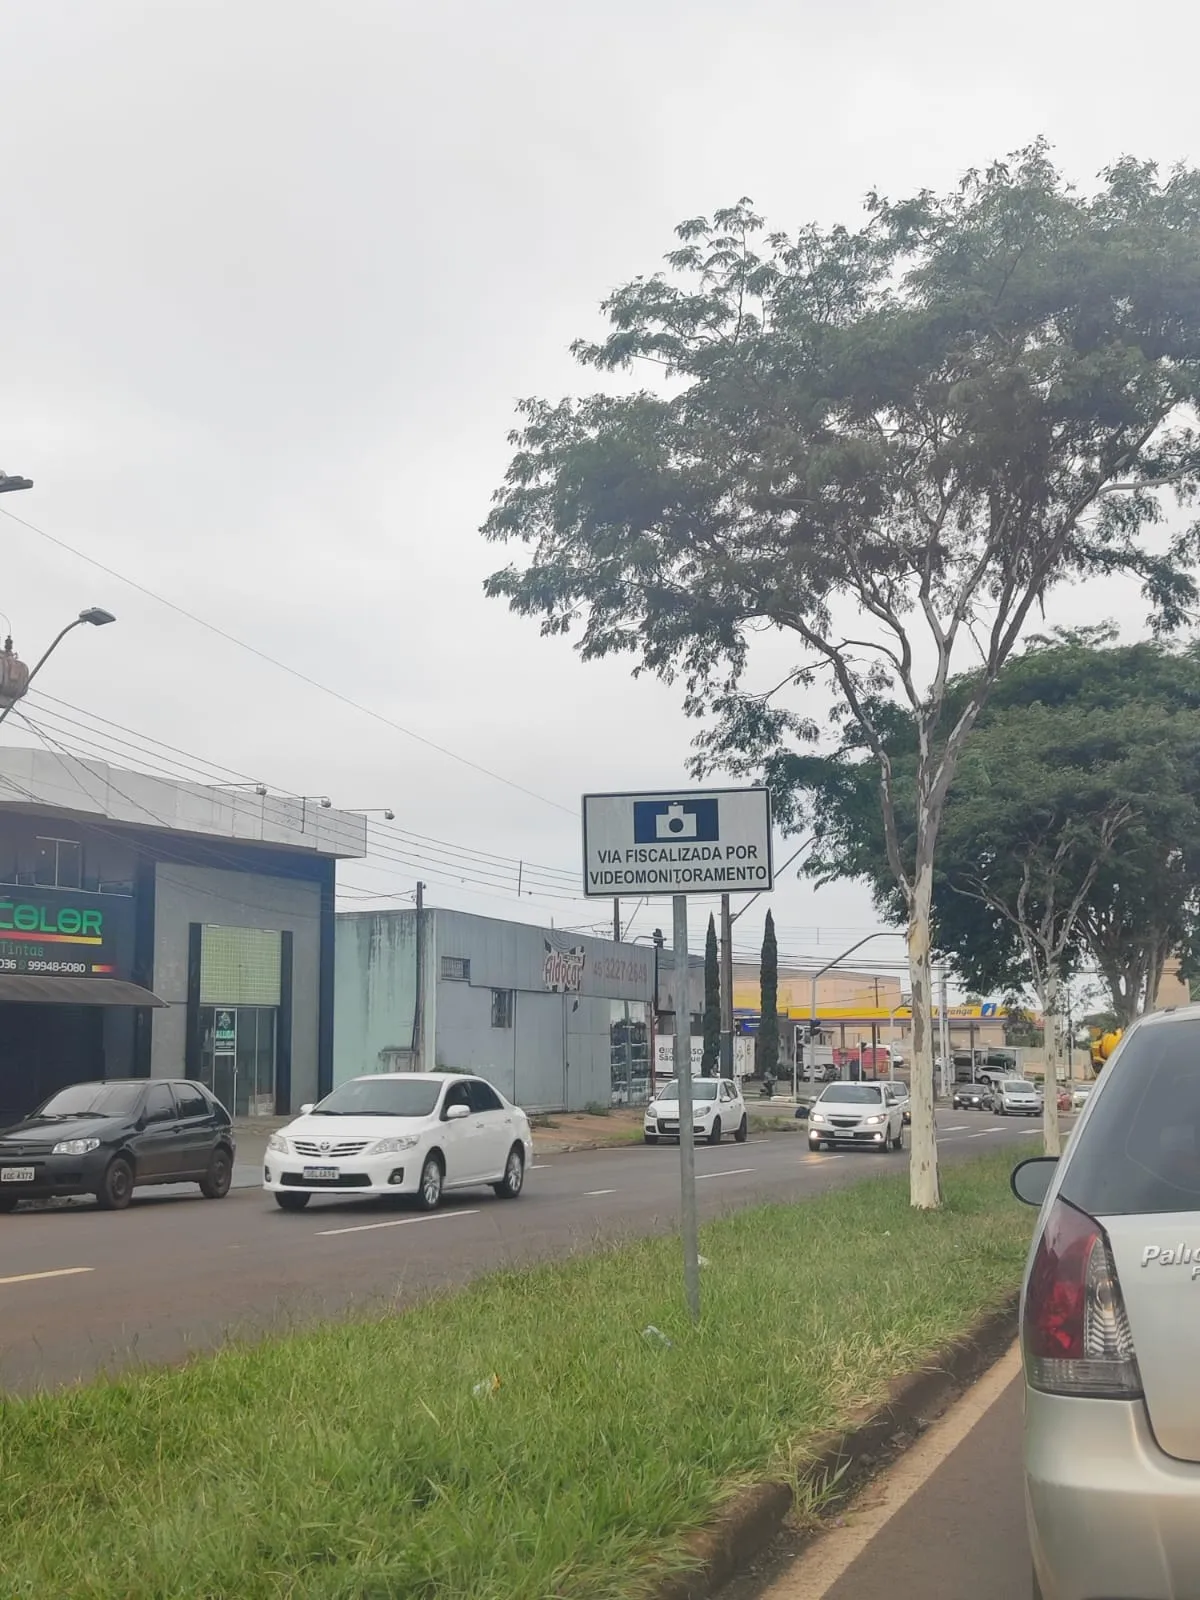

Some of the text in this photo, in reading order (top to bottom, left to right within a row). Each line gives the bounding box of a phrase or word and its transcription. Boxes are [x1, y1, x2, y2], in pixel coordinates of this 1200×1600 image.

[598, 845, 758, 864] VIA FISCALIZADA POR
[590, 865, 767, 885] VIDEOMONITORAMENTO
[28, 960, 86, 973] 99948-5080
